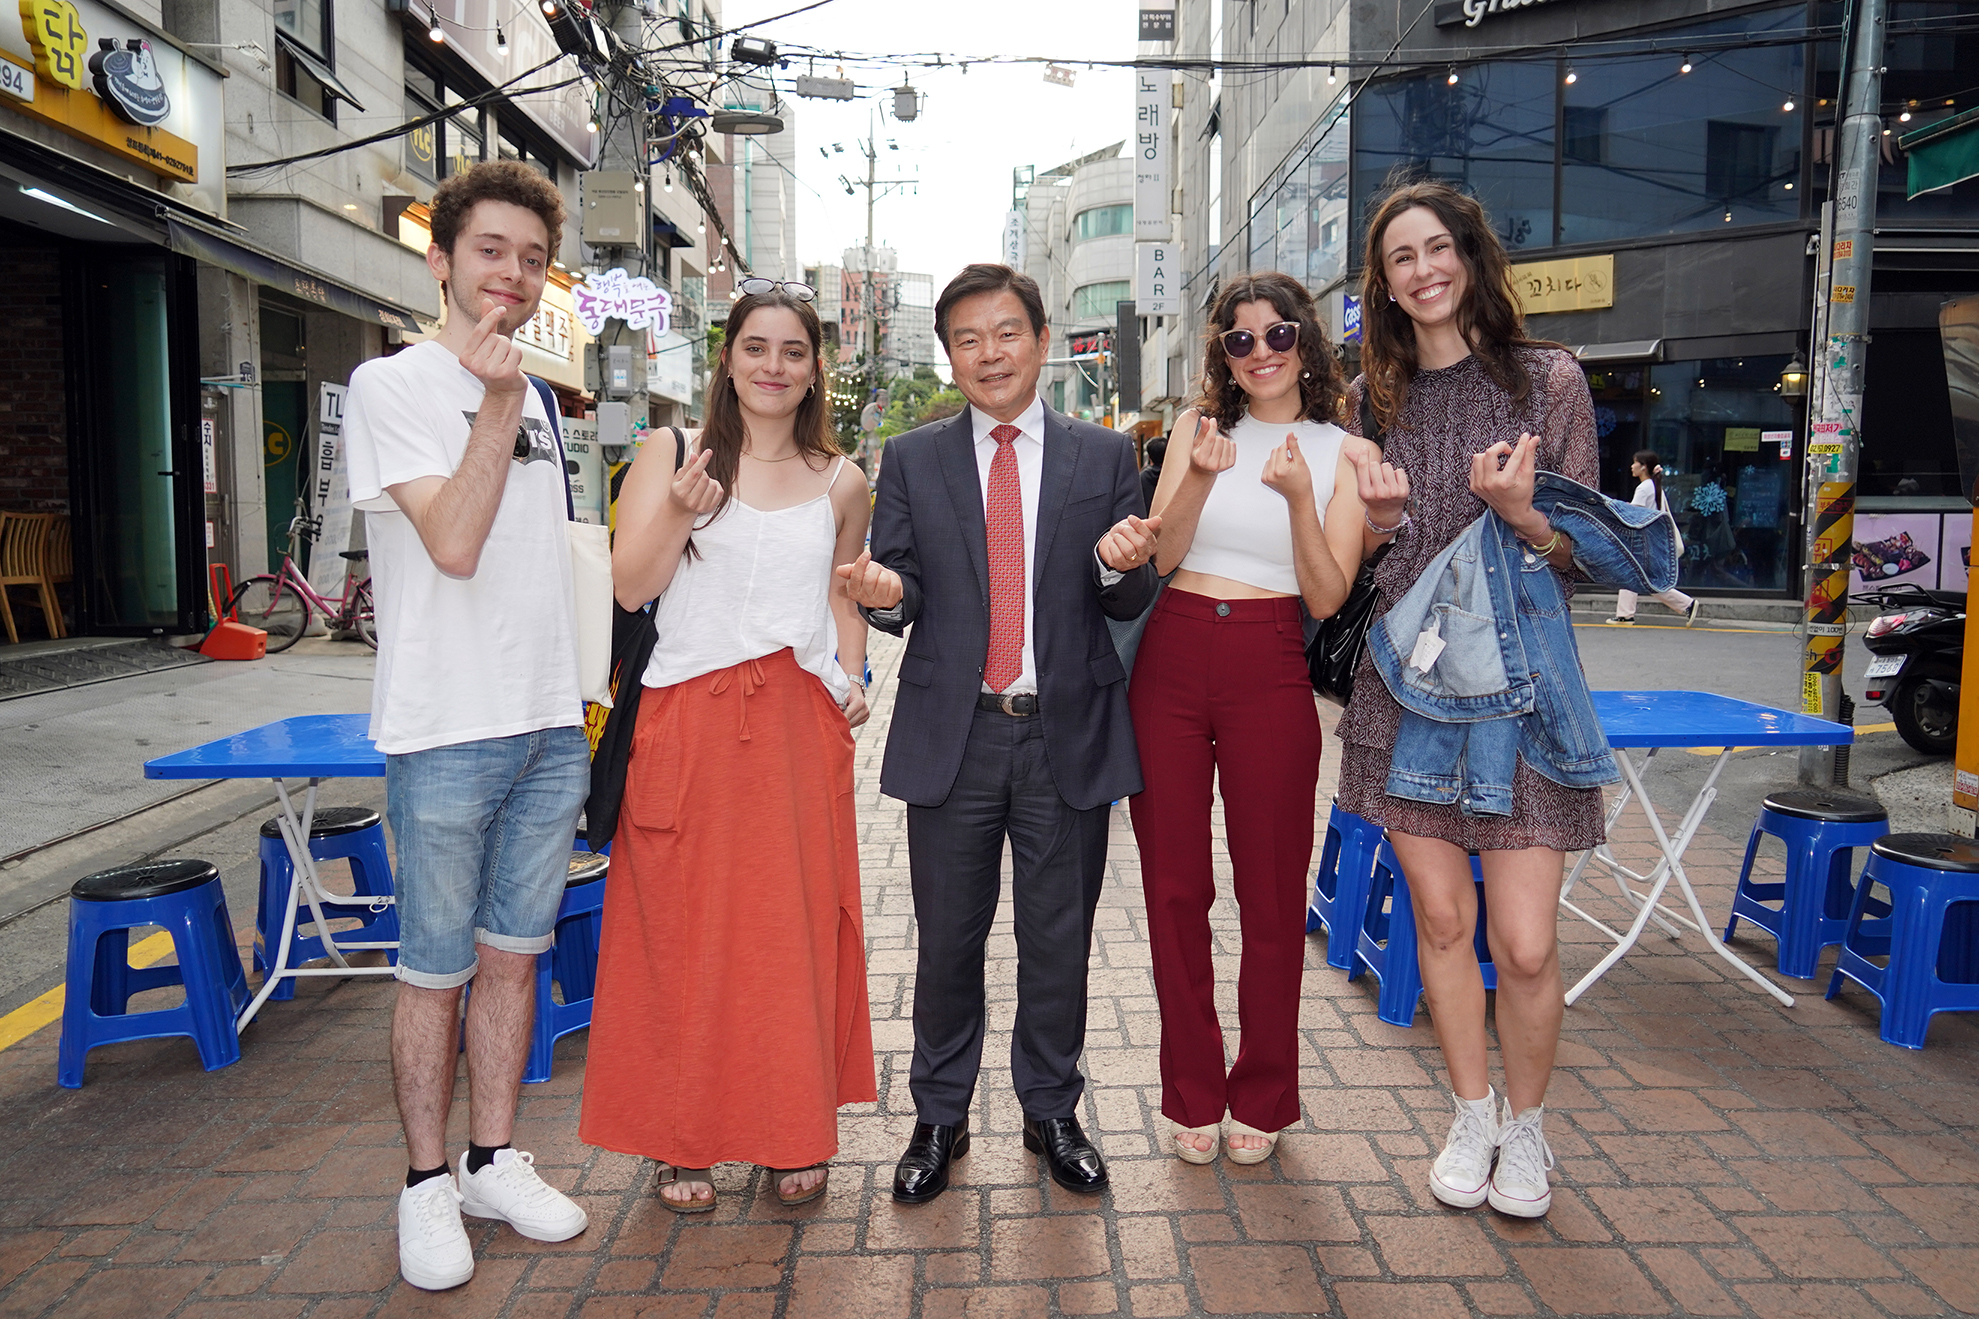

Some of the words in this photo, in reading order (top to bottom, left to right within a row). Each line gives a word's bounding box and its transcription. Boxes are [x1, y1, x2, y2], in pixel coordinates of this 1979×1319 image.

[0, 64, 24, 93] 94
[1138, 76, 1159, 160] 노래방
[1153, 248, 1165, 296] BAR
[577, 290, 667, 331] 동대문구
[1153, 302, 1165, 311] 2F
[1875, 663, 1899, 674] 7568
